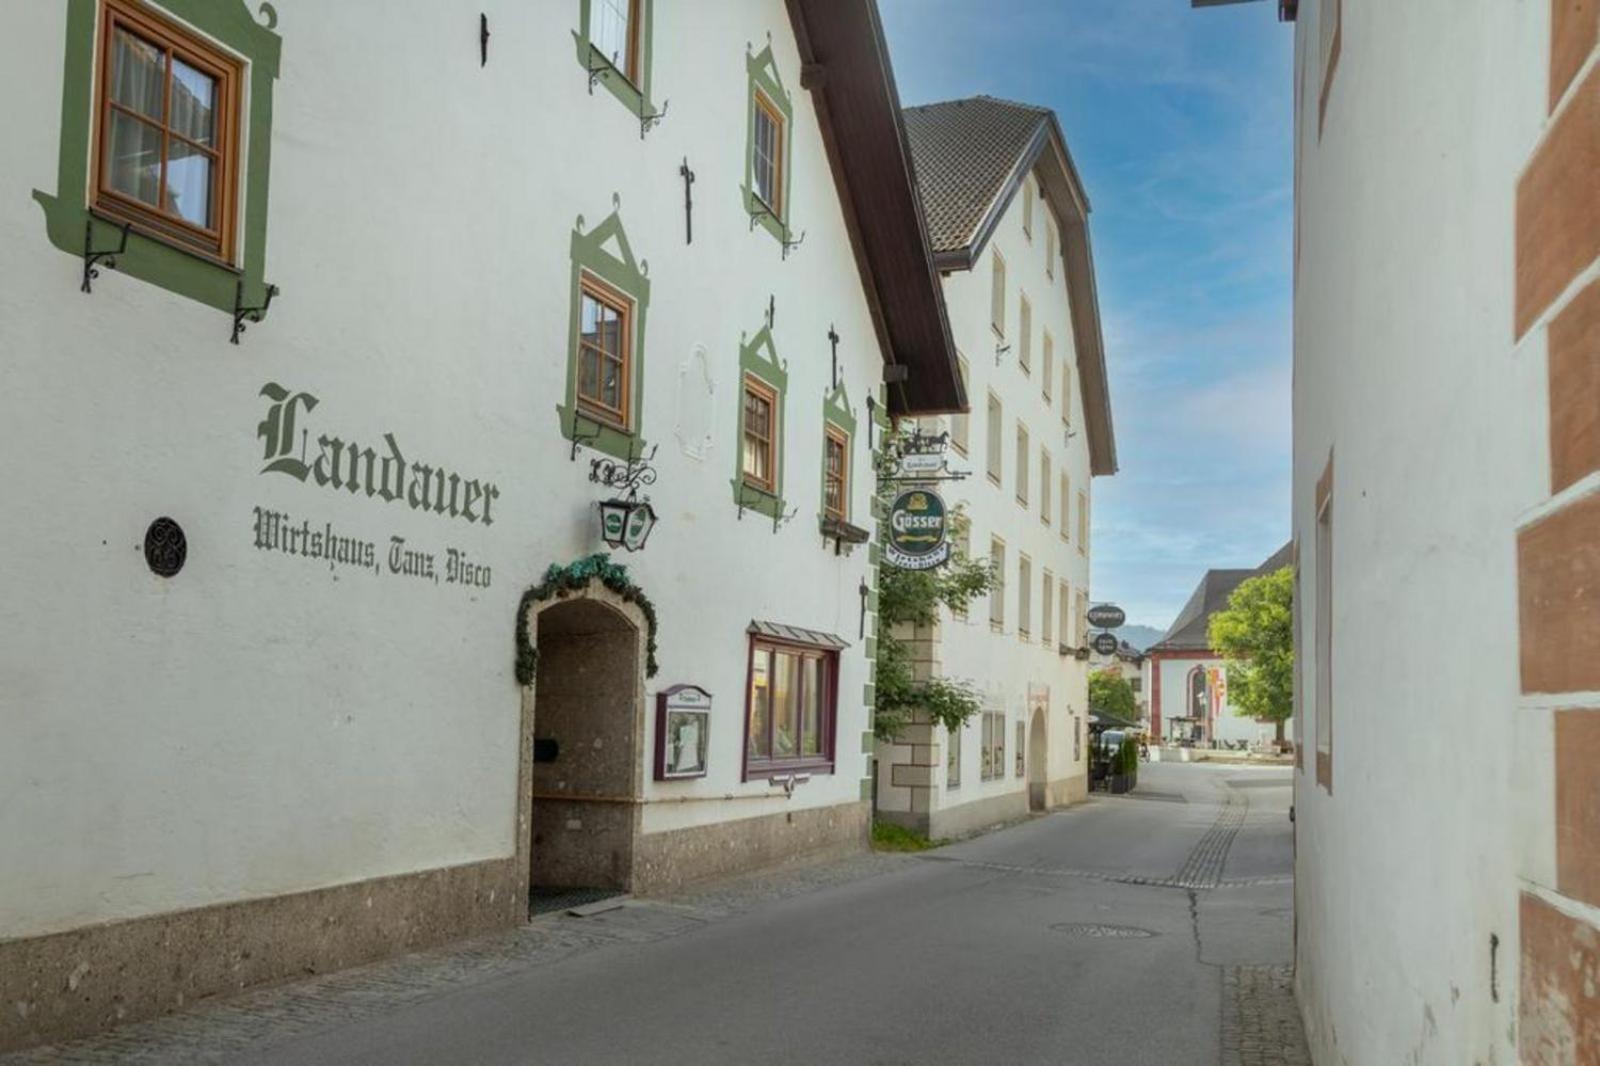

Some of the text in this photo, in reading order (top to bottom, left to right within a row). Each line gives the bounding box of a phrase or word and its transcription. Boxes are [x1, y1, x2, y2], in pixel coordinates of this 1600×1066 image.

[257, 382, 500, 526] Landauer
[253, 506, 491, 588] Wirtshaus, Tanz, Disco
[892, 509, 942, 532] Gösser
